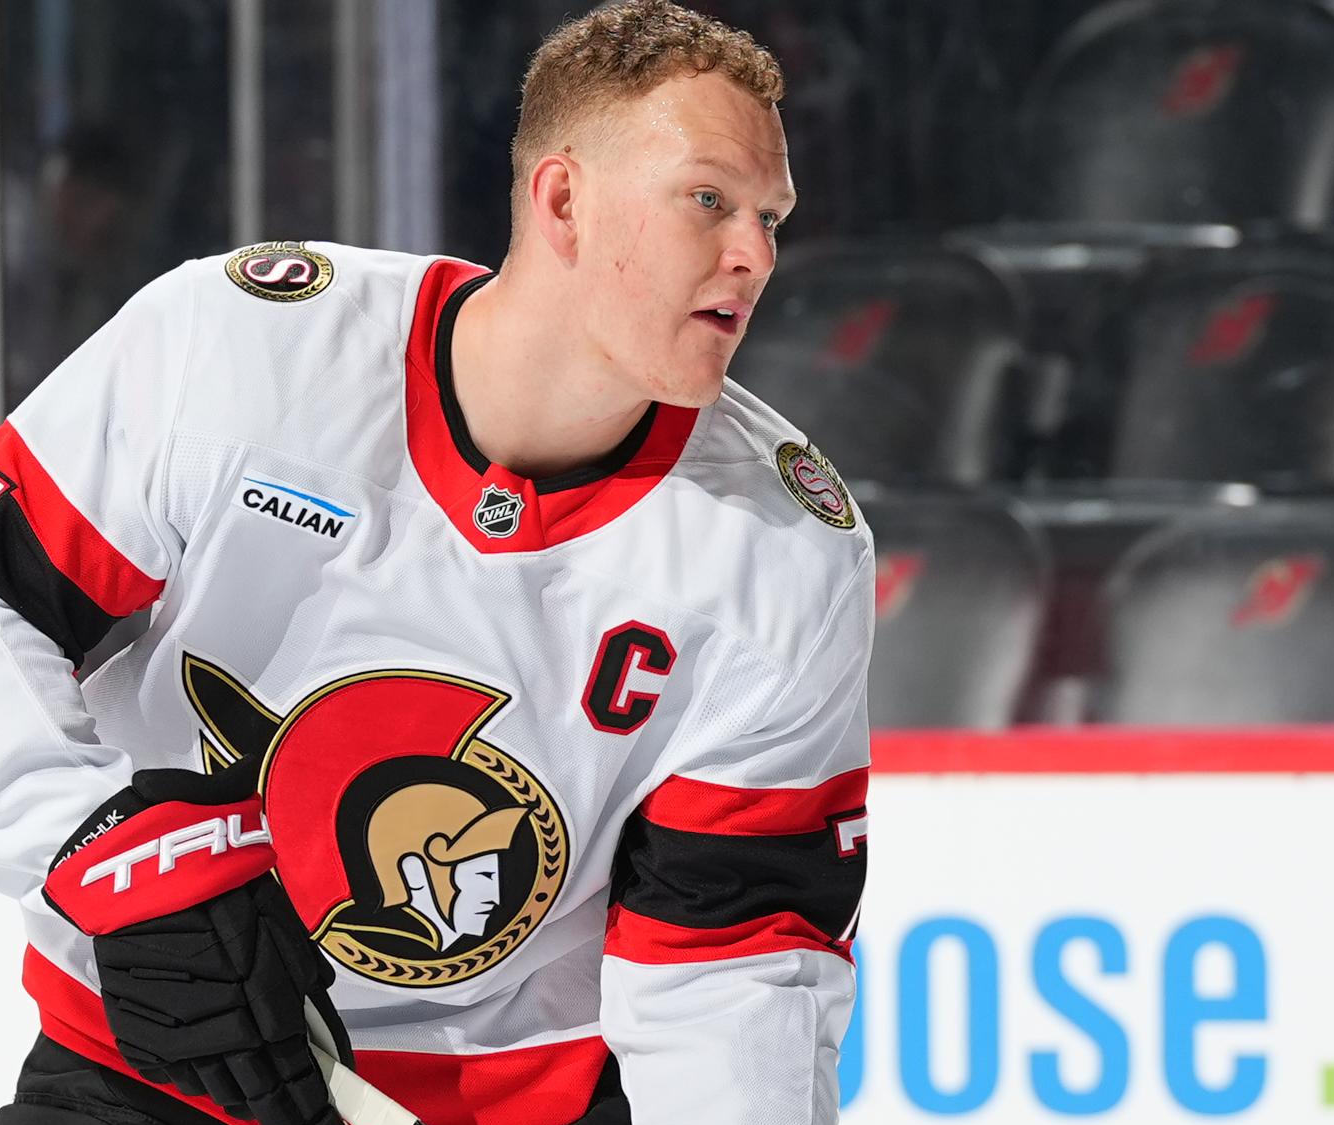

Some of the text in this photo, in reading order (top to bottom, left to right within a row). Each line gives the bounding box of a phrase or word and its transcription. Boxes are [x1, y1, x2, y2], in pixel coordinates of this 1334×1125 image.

[242, 488, 345, 539] CALIAN
[481, 504, 513, 524] NHL
[580, 619, 677, 736] C
